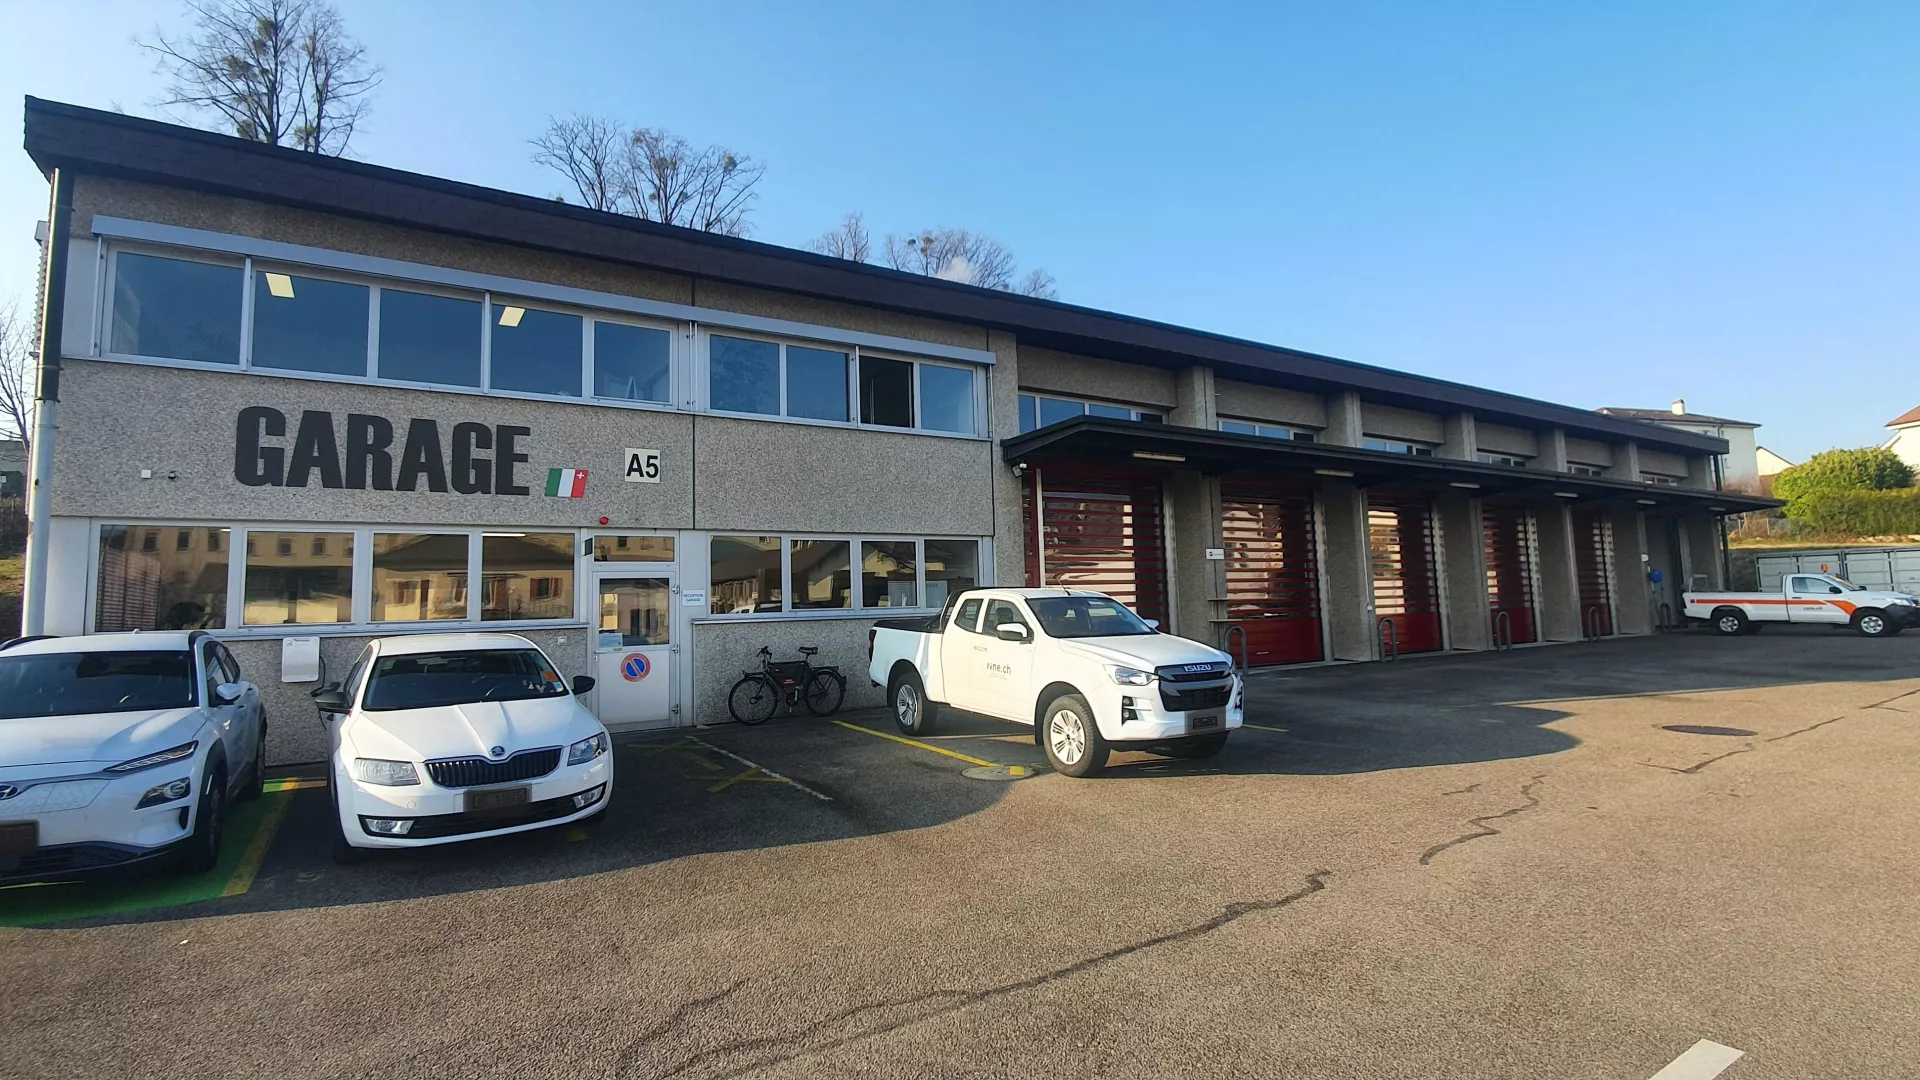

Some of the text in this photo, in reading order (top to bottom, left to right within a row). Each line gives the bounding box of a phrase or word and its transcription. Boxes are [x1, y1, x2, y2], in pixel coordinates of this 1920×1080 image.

[234, 406, 531, 496] GARAGE
[626, 453, 659, 479] A5
[1184, 664, 1212, 672] ISUZU
